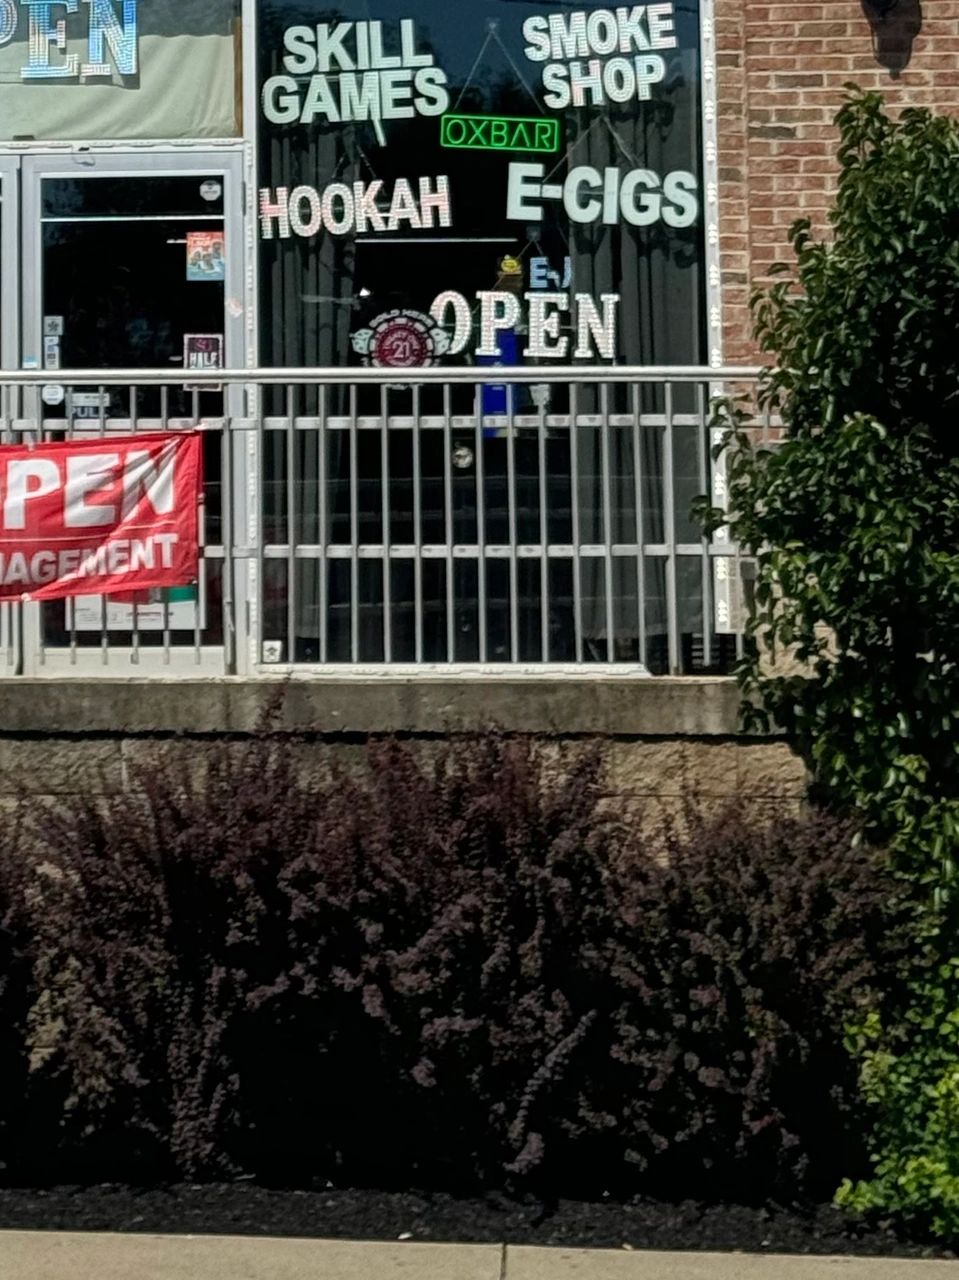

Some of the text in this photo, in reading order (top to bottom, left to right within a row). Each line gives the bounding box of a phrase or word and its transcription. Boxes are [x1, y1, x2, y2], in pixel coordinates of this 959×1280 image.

[282, 18, 434, 75] SKILL
[522, 1, 678, 63] SMOKE
[262, 66, 451, 125] GAMES
[541, 54, 667, 110] SHOP
[445, 118, 557, 150] OXBAR
[259, 175, 453, 240] HOOKAH
[506, 162, 699, 228] E-CIGS
[428, 290, 620, 359] OPEN
